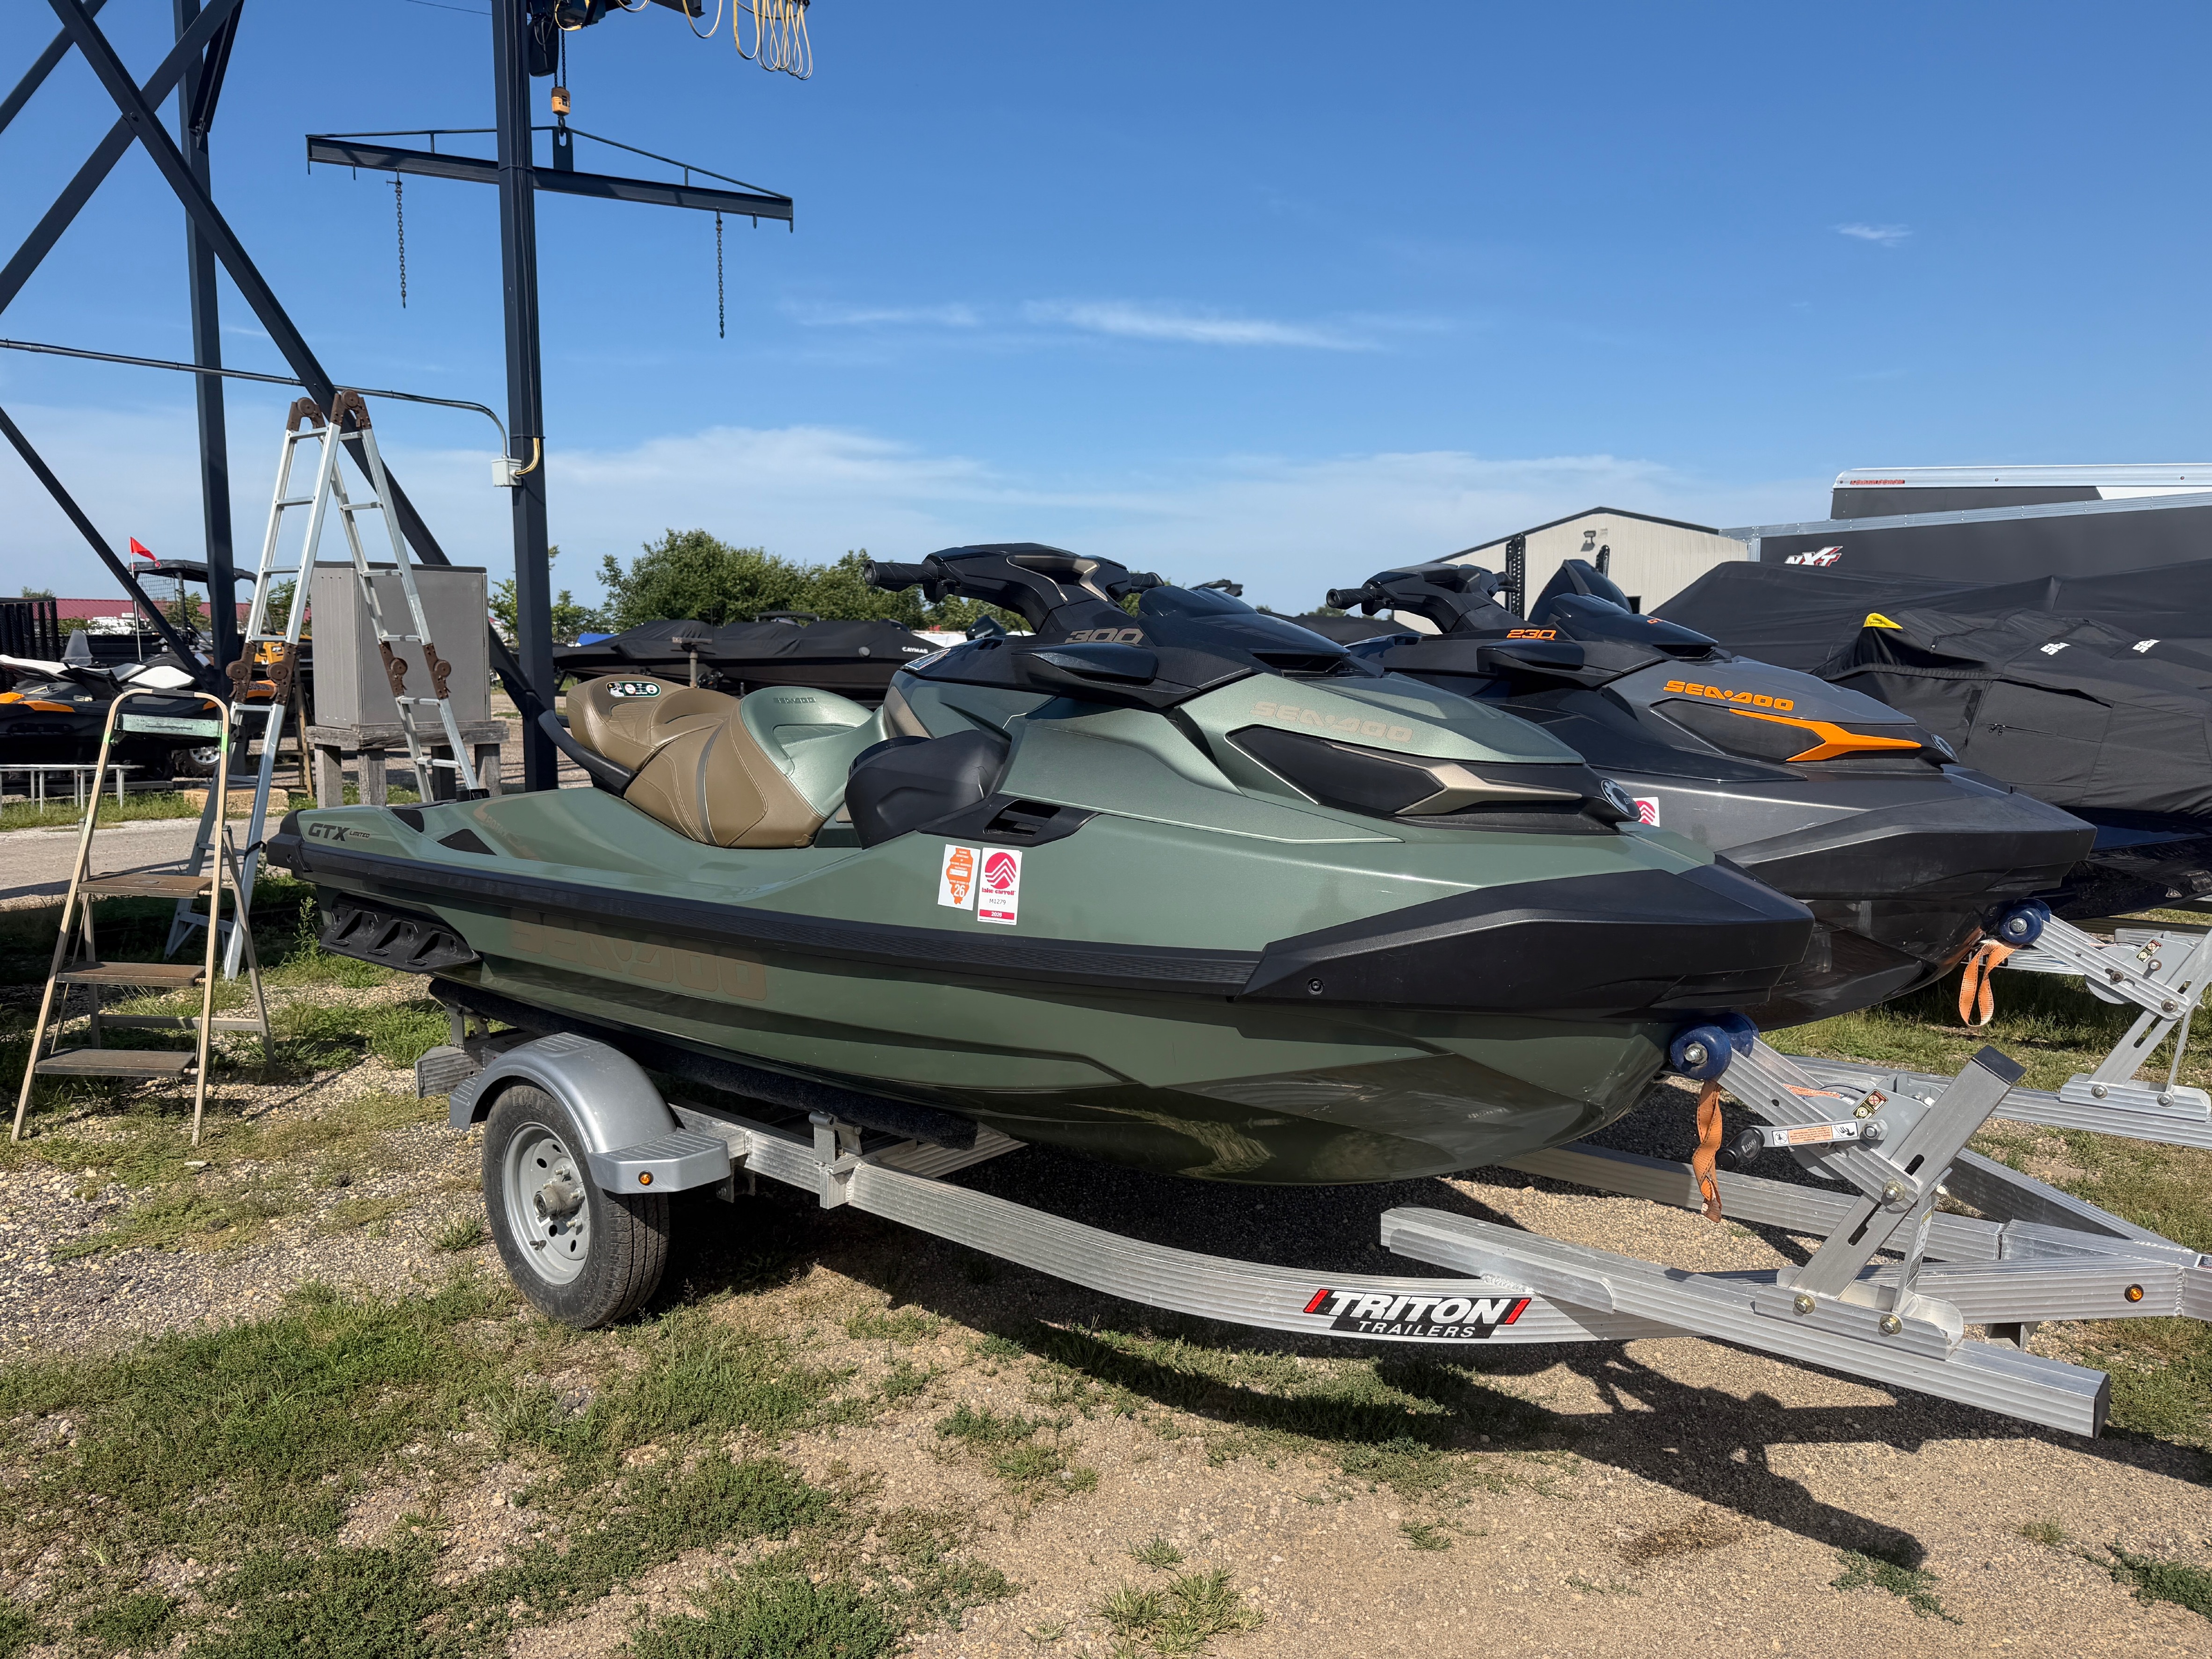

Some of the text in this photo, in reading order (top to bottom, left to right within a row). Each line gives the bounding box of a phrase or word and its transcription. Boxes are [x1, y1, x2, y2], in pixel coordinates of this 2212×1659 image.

[1065, 628, 1144, 645] 300
[1507, 629, 1557, 640] 230
[308, 822, 350, 842] GTX
[954, 884, 966, 898] 26
[1328, 1290, 1507, 1324] TRITON
[1358, 1320, 1475, 1338] TRAILERS
